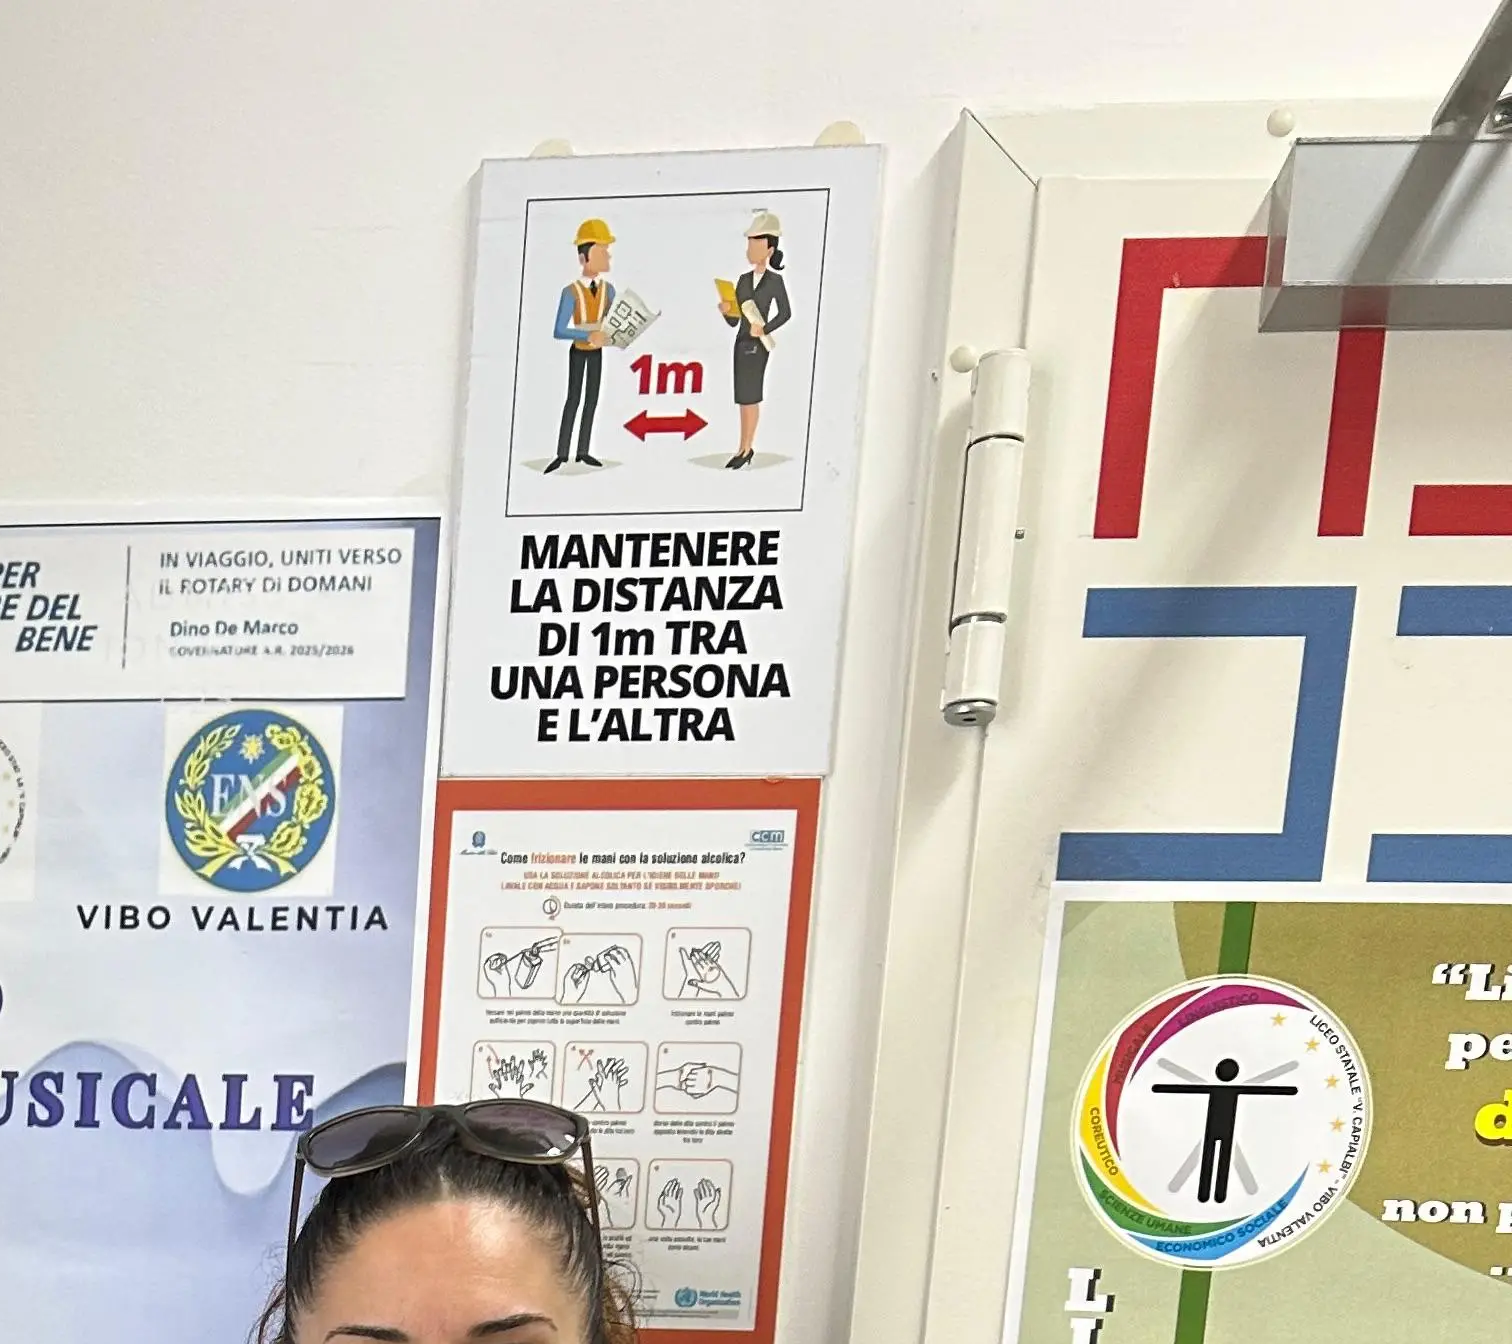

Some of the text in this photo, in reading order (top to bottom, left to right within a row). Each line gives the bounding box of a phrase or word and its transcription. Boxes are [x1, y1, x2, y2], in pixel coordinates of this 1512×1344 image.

[629, 354, 703, 394] 1m
[160, 548, 402, 569] IN VIAGGIO, UNITI VERSO
[520, 530, 780, 569] MANTENERE
[288, 576, 372, 592] DOMANI
[510, 575, 783, 614] LA DISTANZA
[25, 595, 82, 620] DEL
[15, 626, 97, 652] BENE
[170, 620, 299, 636] Dino De Marco
[538, 620, 747, 657] DI 1m TRA
[490, 663, 790, 700] UNA PERSONA
[537, 706, 735, 742] E L’ALTRA
[501, 851, 528, 865] Come
[592, 851, 616, 865] mani
[620, 851, 637, 865] con
[652, 851, 698, 865] soluzione
[77, 905, 389, 932] VIBO VALENTIA
[1090, 1107, 1119, 1176] COREUTICO
[1258, 1015, 1362, 1249] LICEO STATALE VIBO VALENTIA
[1155, 1200, 1288, 1253] ECONOMICO SOCIALE
[1381, 1199, 1486, 1224] non
